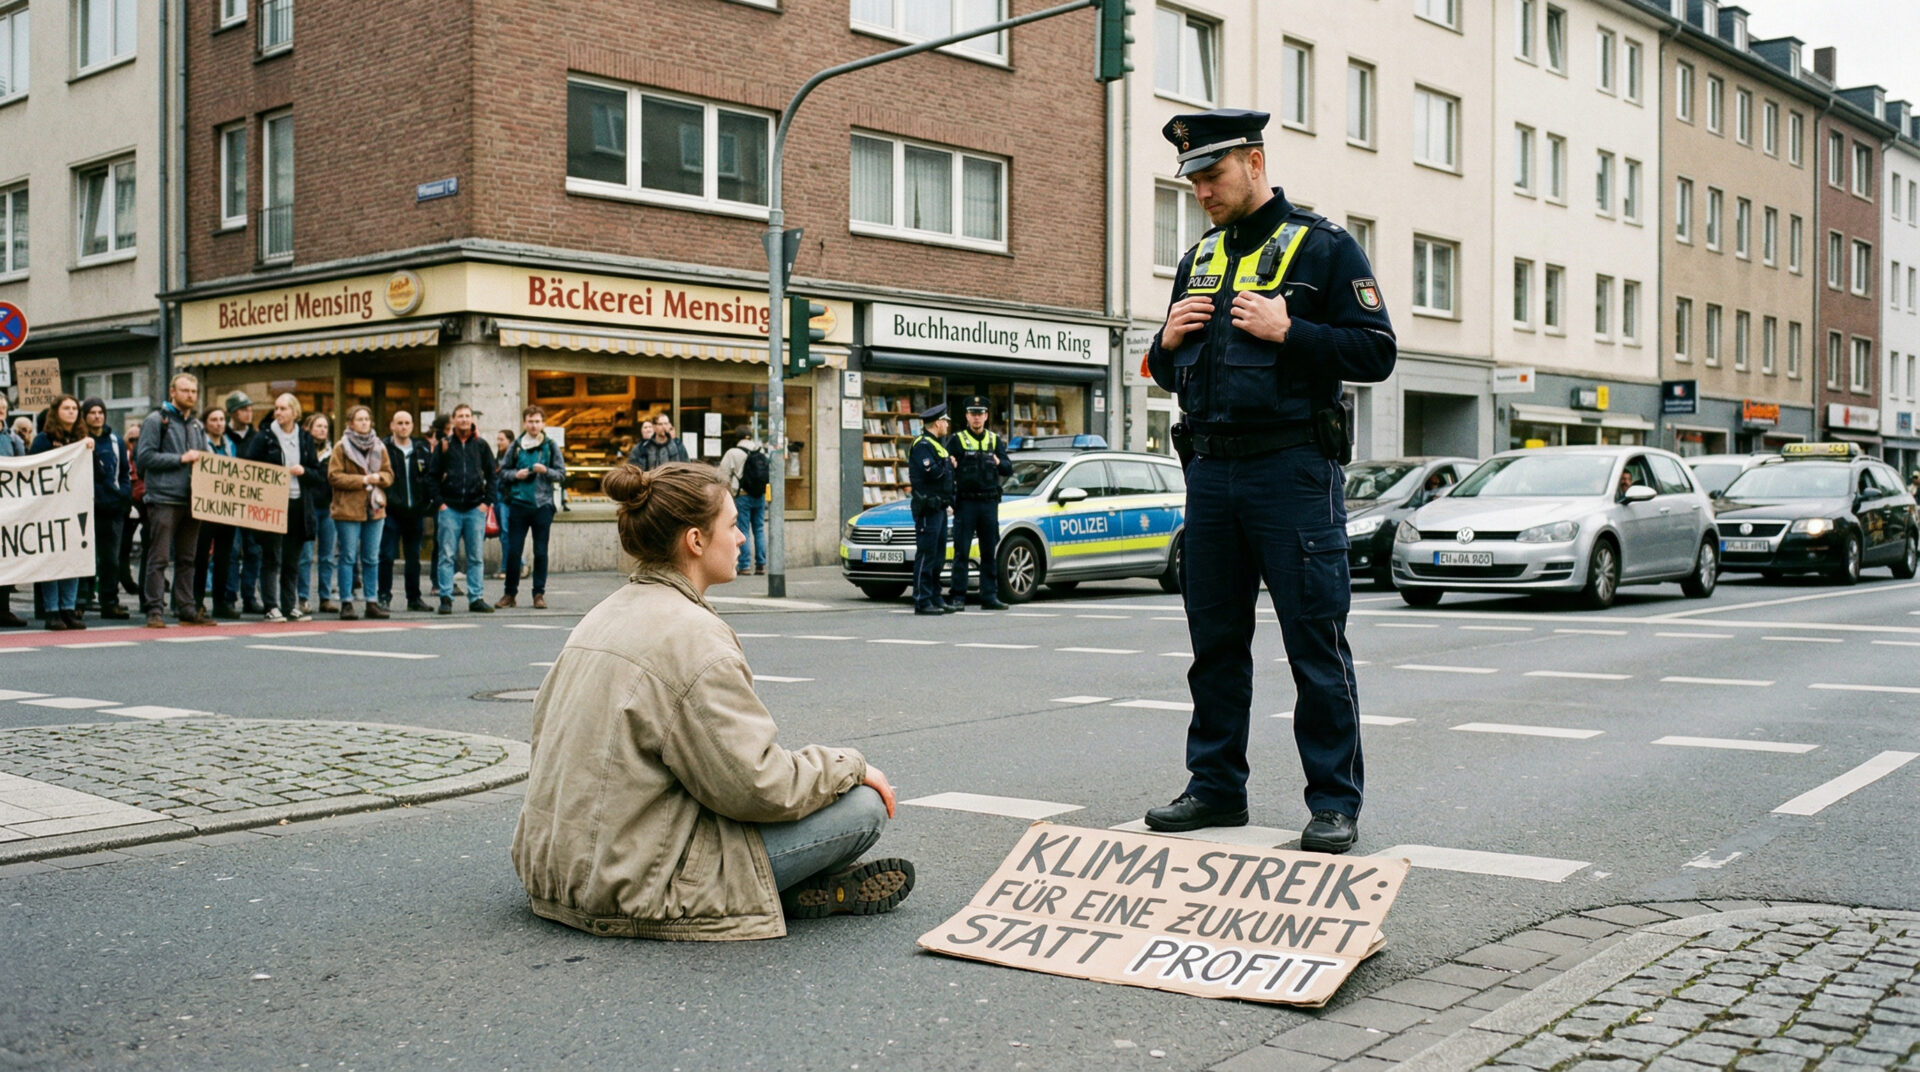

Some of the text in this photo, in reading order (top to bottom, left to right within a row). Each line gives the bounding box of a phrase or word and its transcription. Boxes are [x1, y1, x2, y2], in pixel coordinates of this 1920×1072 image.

[1187, 276, 1218, 287] POLIZEI
[218, 286, 373, 329] Bäckerei Mensing
[528, 275, 770, 334] Bäckerei Mensing
[893, 313, 1092, 359] Buchhandlung Am Ring
[200, 455, 287, 487] KLIMA-STREIK:
[214, 479, 265, 502] FÜR EINE
[193, 496, 285, 525] ZUKUNFT PROFIT
[1060, 516, 1108, 536] POLIZEI
[1016, 831, 1390, 911] KLIMA-STREIK:
[986, 879, 1371, 953] FÜR EINE ZUKUNFT
[947, 914, 1339, 994] STATT PROFIT
